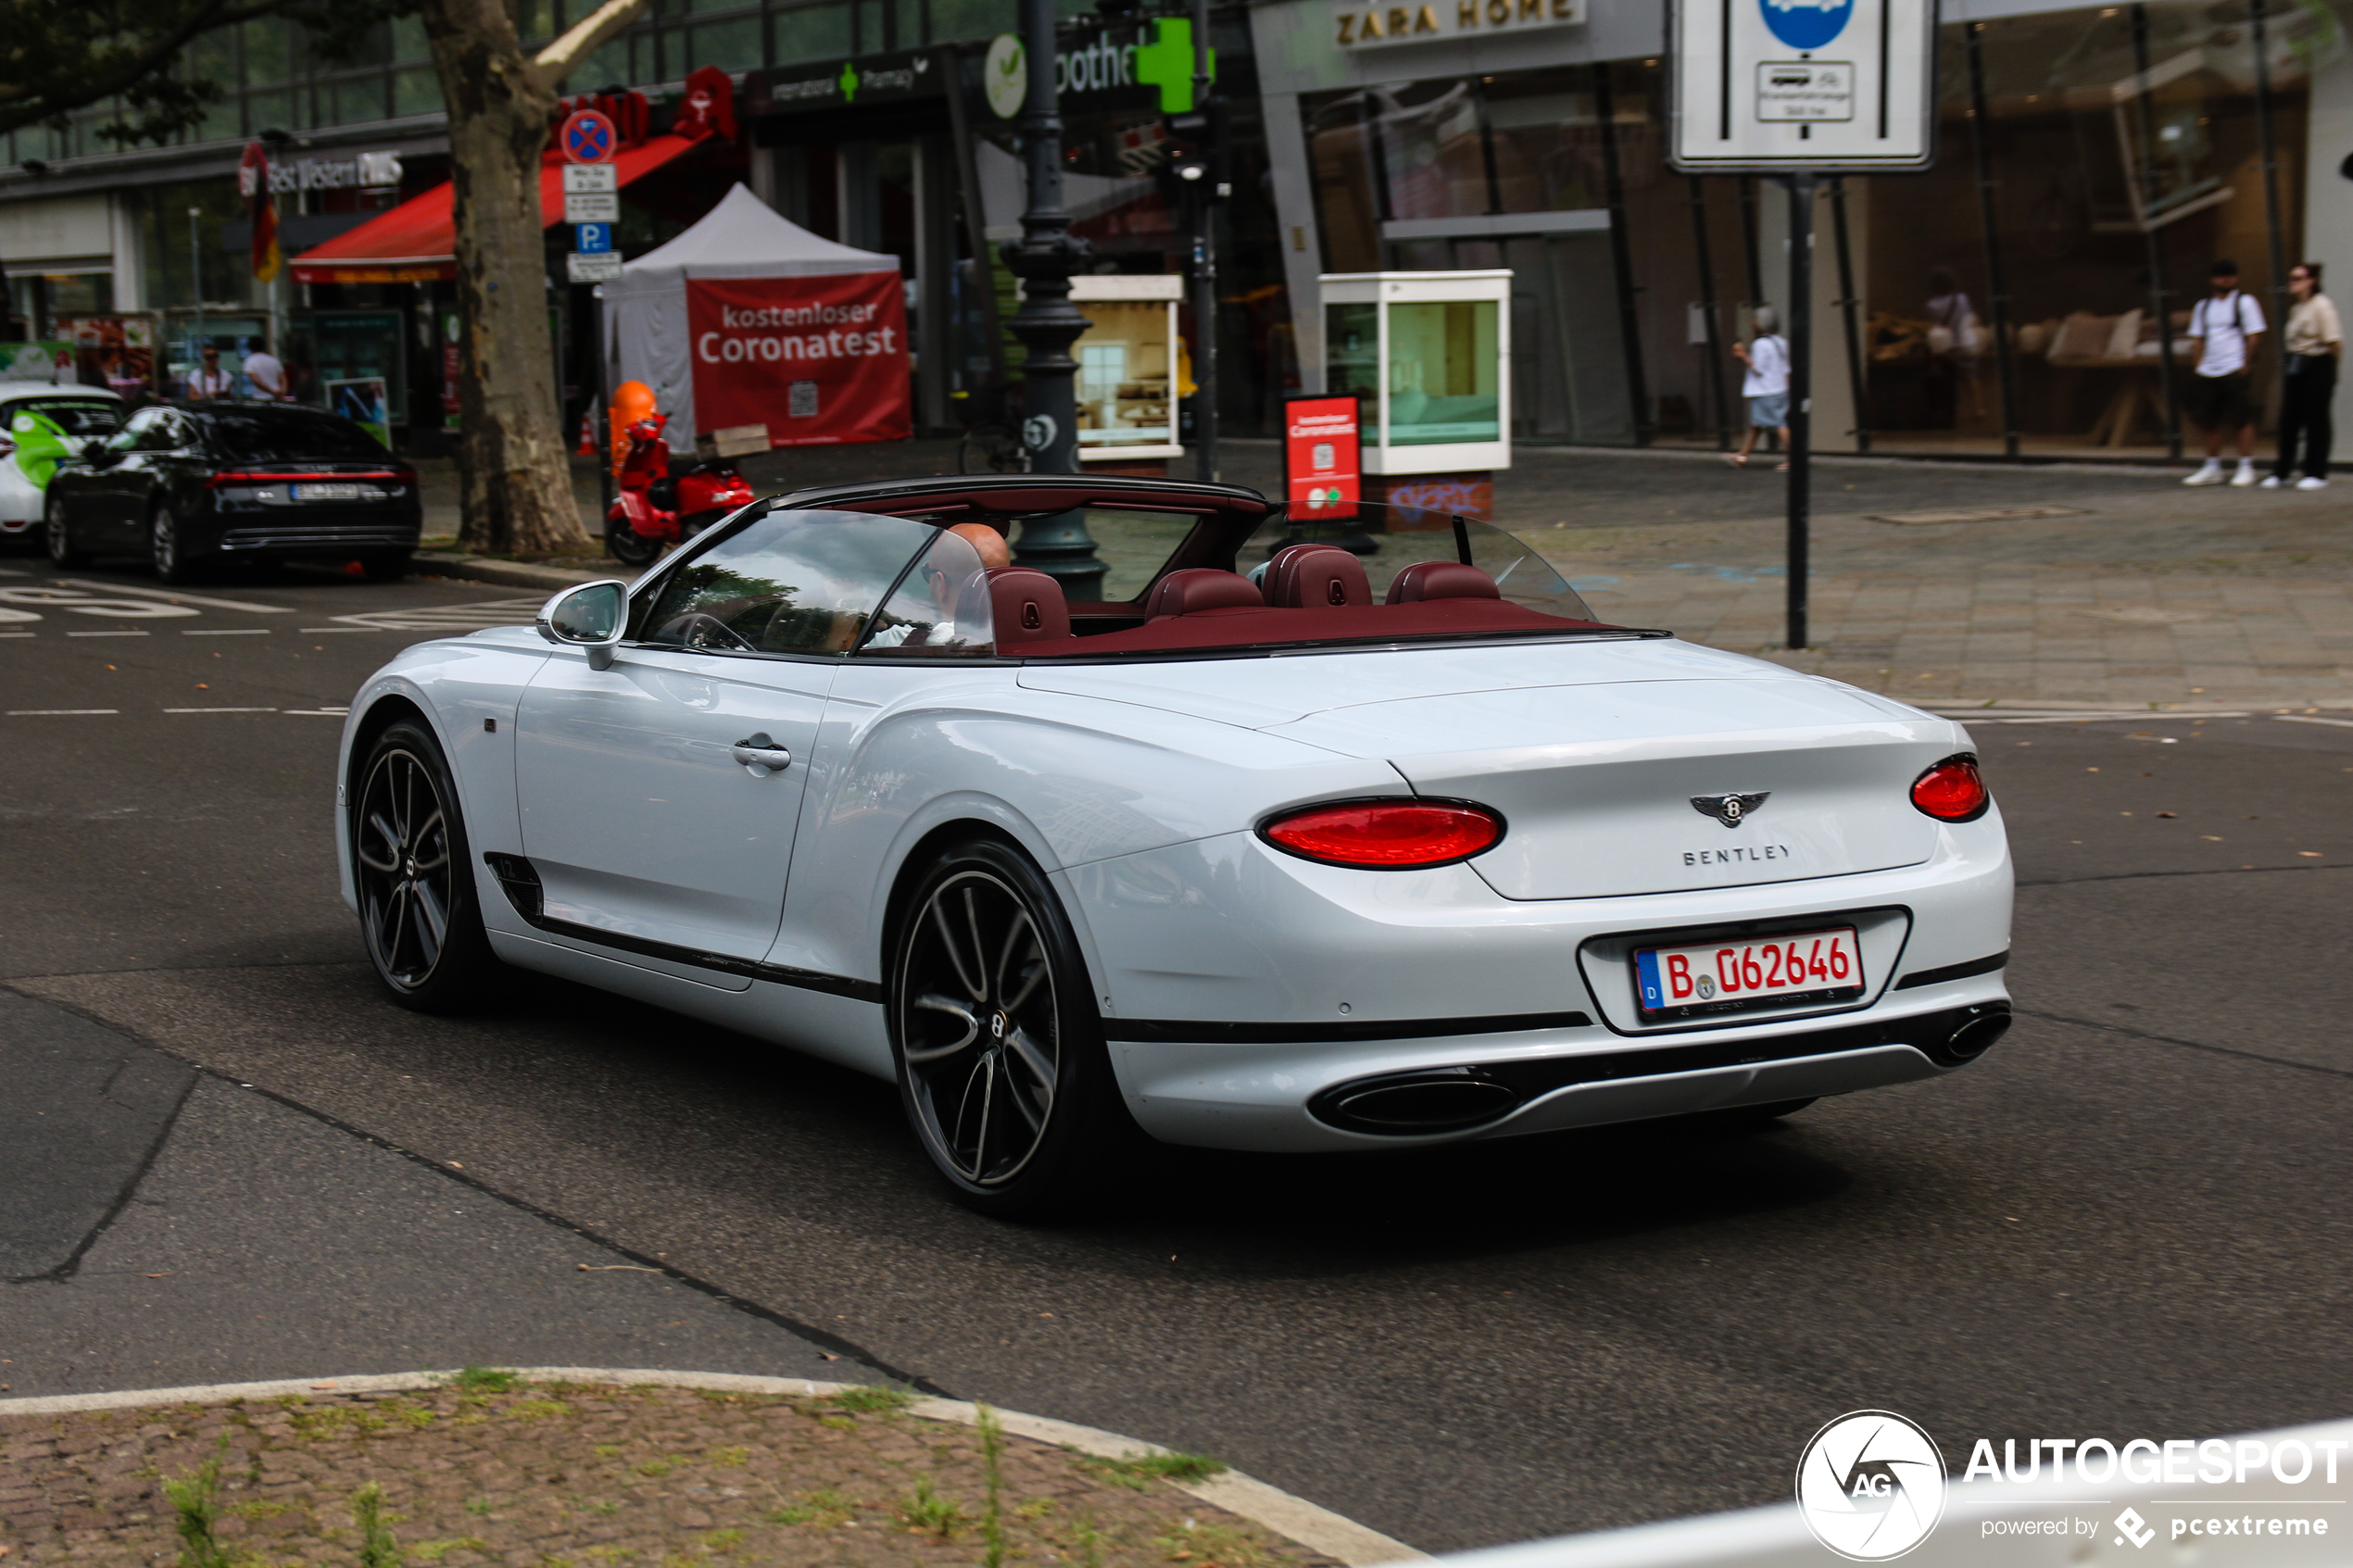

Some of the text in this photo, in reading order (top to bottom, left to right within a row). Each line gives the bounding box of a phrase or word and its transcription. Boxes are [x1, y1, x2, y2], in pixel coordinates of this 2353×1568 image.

[1337, 0, 1573, 44] ZARA HOME
[724, 302, 877, 328] kostenloser
[698, 326, 897, 364] Coronatest
[1726, 801, 1741, 817] B
[1682, 844, 1790, 867] BENTLEY
[1667, 936, 1849, 998] B 062646
[1646, 986, 1657, 1000] D
